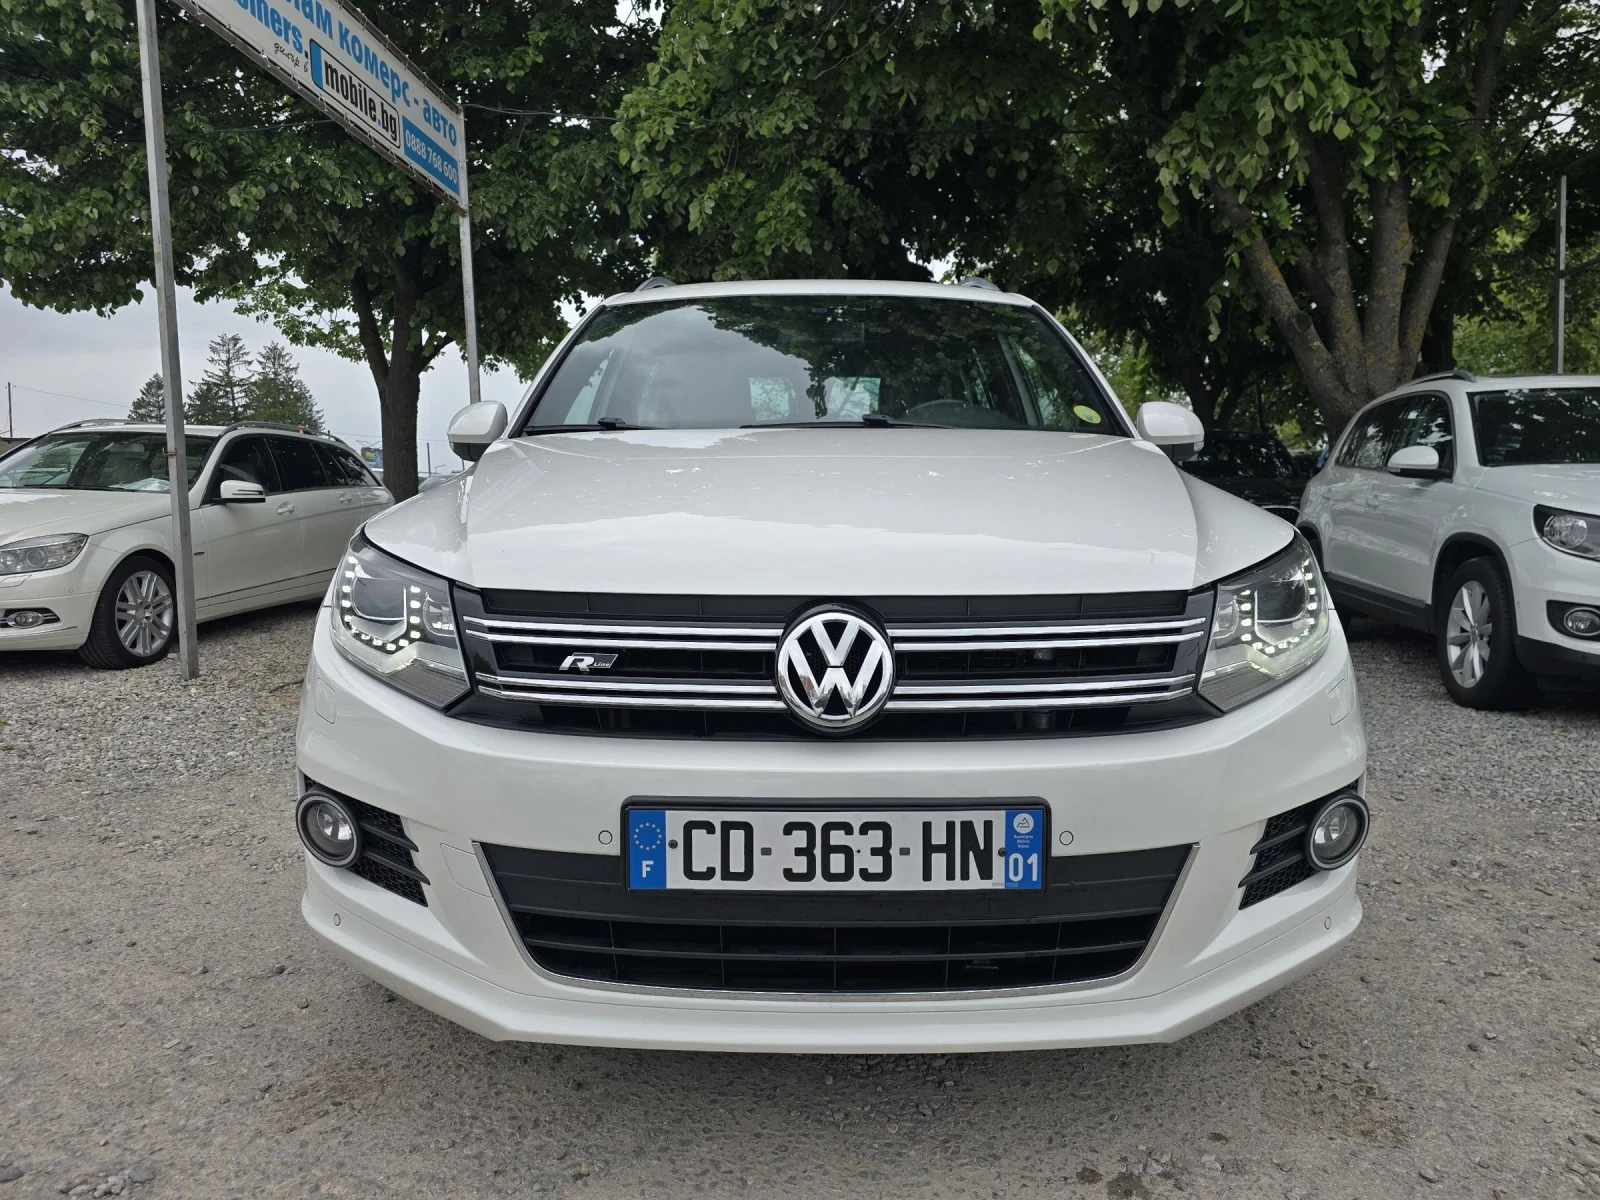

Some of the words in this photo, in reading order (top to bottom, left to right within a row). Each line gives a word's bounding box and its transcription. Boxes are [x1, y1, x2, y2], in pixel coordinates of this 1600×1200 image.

[324, 60, 397, 142] mobile.bg
[405, 129, 426, 160] 0888
[427, 147, 443, 173] 768
[443, 161, 457, 184] 600
[642, 860, 654, 878] F
[1009, 853, 1038, 882] 01
